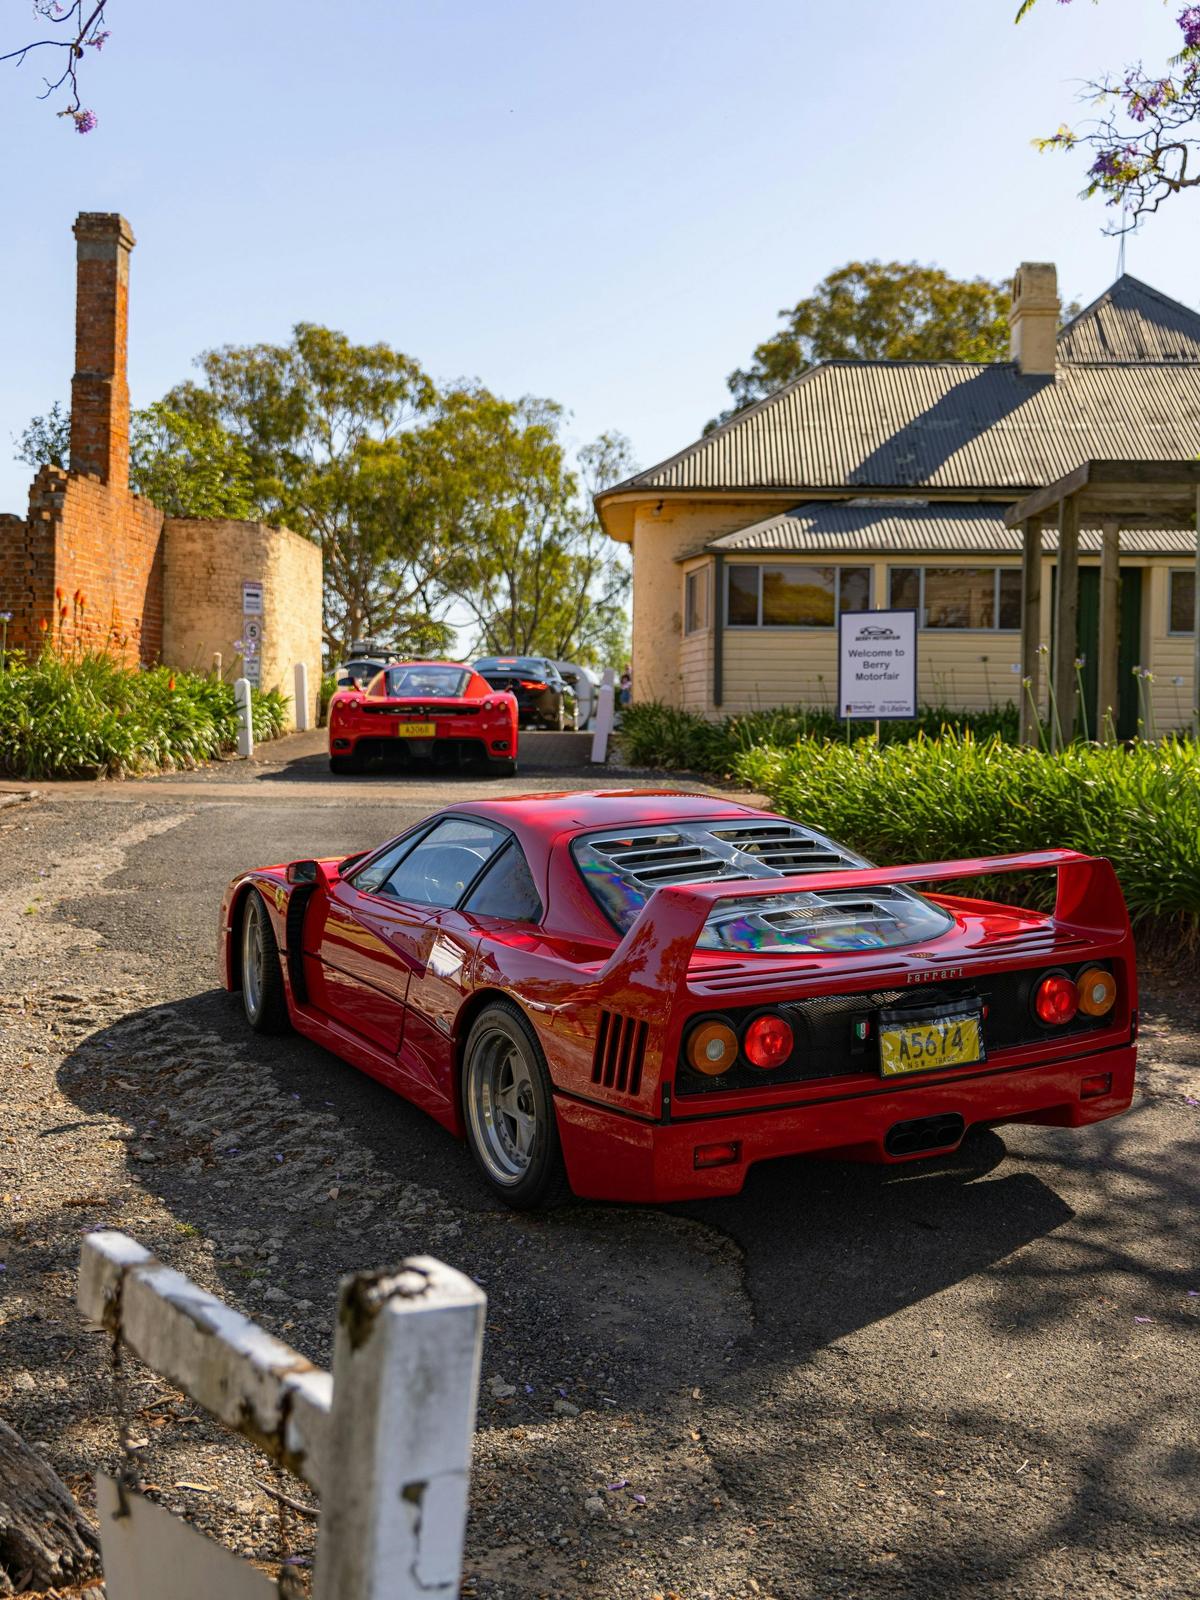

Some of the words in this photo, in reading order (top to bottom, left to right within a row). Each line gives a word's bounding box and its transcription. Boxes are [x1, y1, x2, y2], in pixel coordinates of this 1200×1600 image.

[249, 626, 257, 637] 5
[848, 649, 893, 658] Welcome
[895, 649, 905, 657] to
[863, 661, 890, 671] Berry
[855, 672, 900, 681] Motorfair
[907, 967, 964, 984] Ferrari
